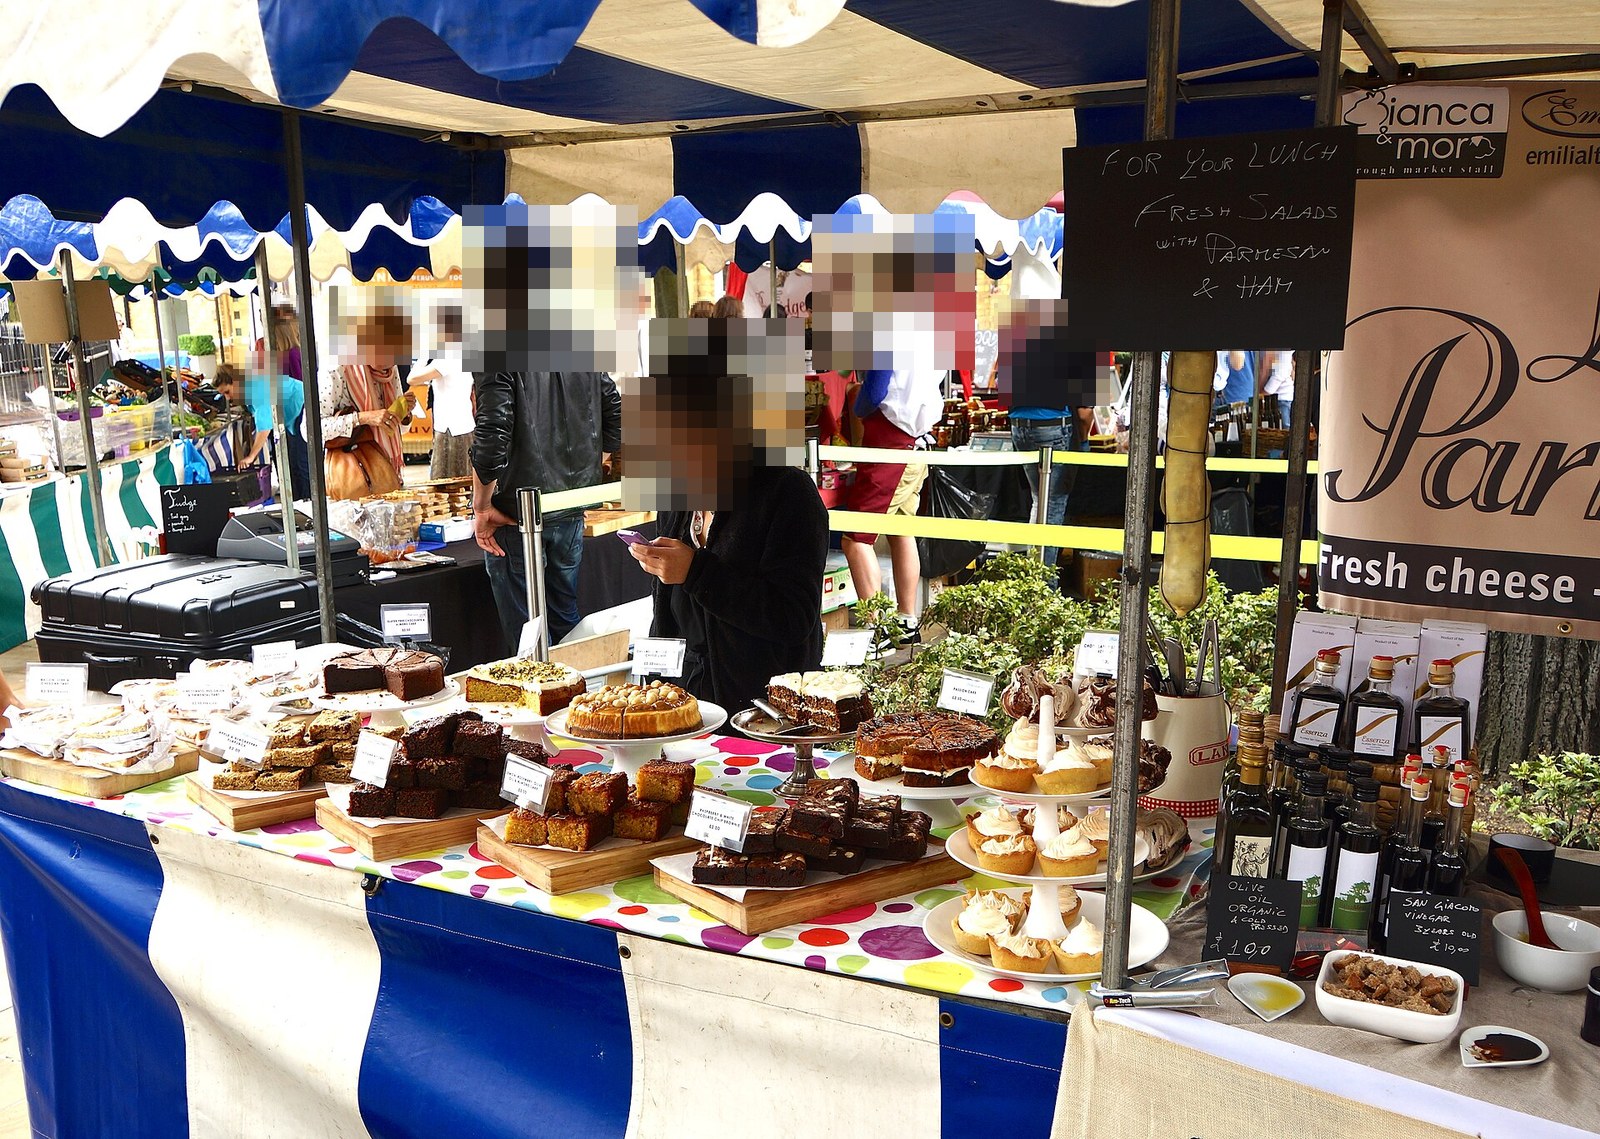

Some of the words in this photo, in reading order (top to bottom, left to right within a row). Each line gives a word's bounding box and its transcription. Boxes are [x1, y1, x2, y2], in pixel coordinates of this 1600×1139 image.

[1540, 95, 1600, 126] Em
[1102, 148, 1162, 177] FOR
[1248, 140, 1340, 169] LUNCH
[1356, 165, 1395, 176] rough
[1403, 164, 1453, 175] market
[1460, 163, 1495, 174] stall
[1134, 193, 1232, 228] FRESH
[1238, 193, 1339, 221] SALADS
[1192, 277, 1219, 300] &
[1236, 274, 1294, 301] HAM
[1322, 306, 1600, 521] Par
[164, 486, 198, 512] Fudge
[1318, 541, 1408, 589] Fresh
[1425, 556, 1576, 604] cheese
[1361, 735, 1390, 745] Essenza
[691, 810, 714, 820] CHOCOLATE
[1228, 881, 1265, 892] OLIVE
[1248, 894, 1272, 904] OIL
[1402, 897, 1429, 907] SAN
[1228, 904, 1287, 916] ORGANIC
[1404, 909, 1451, 923] VINEGAR
[1461, 931, 1477, 939] OLD
